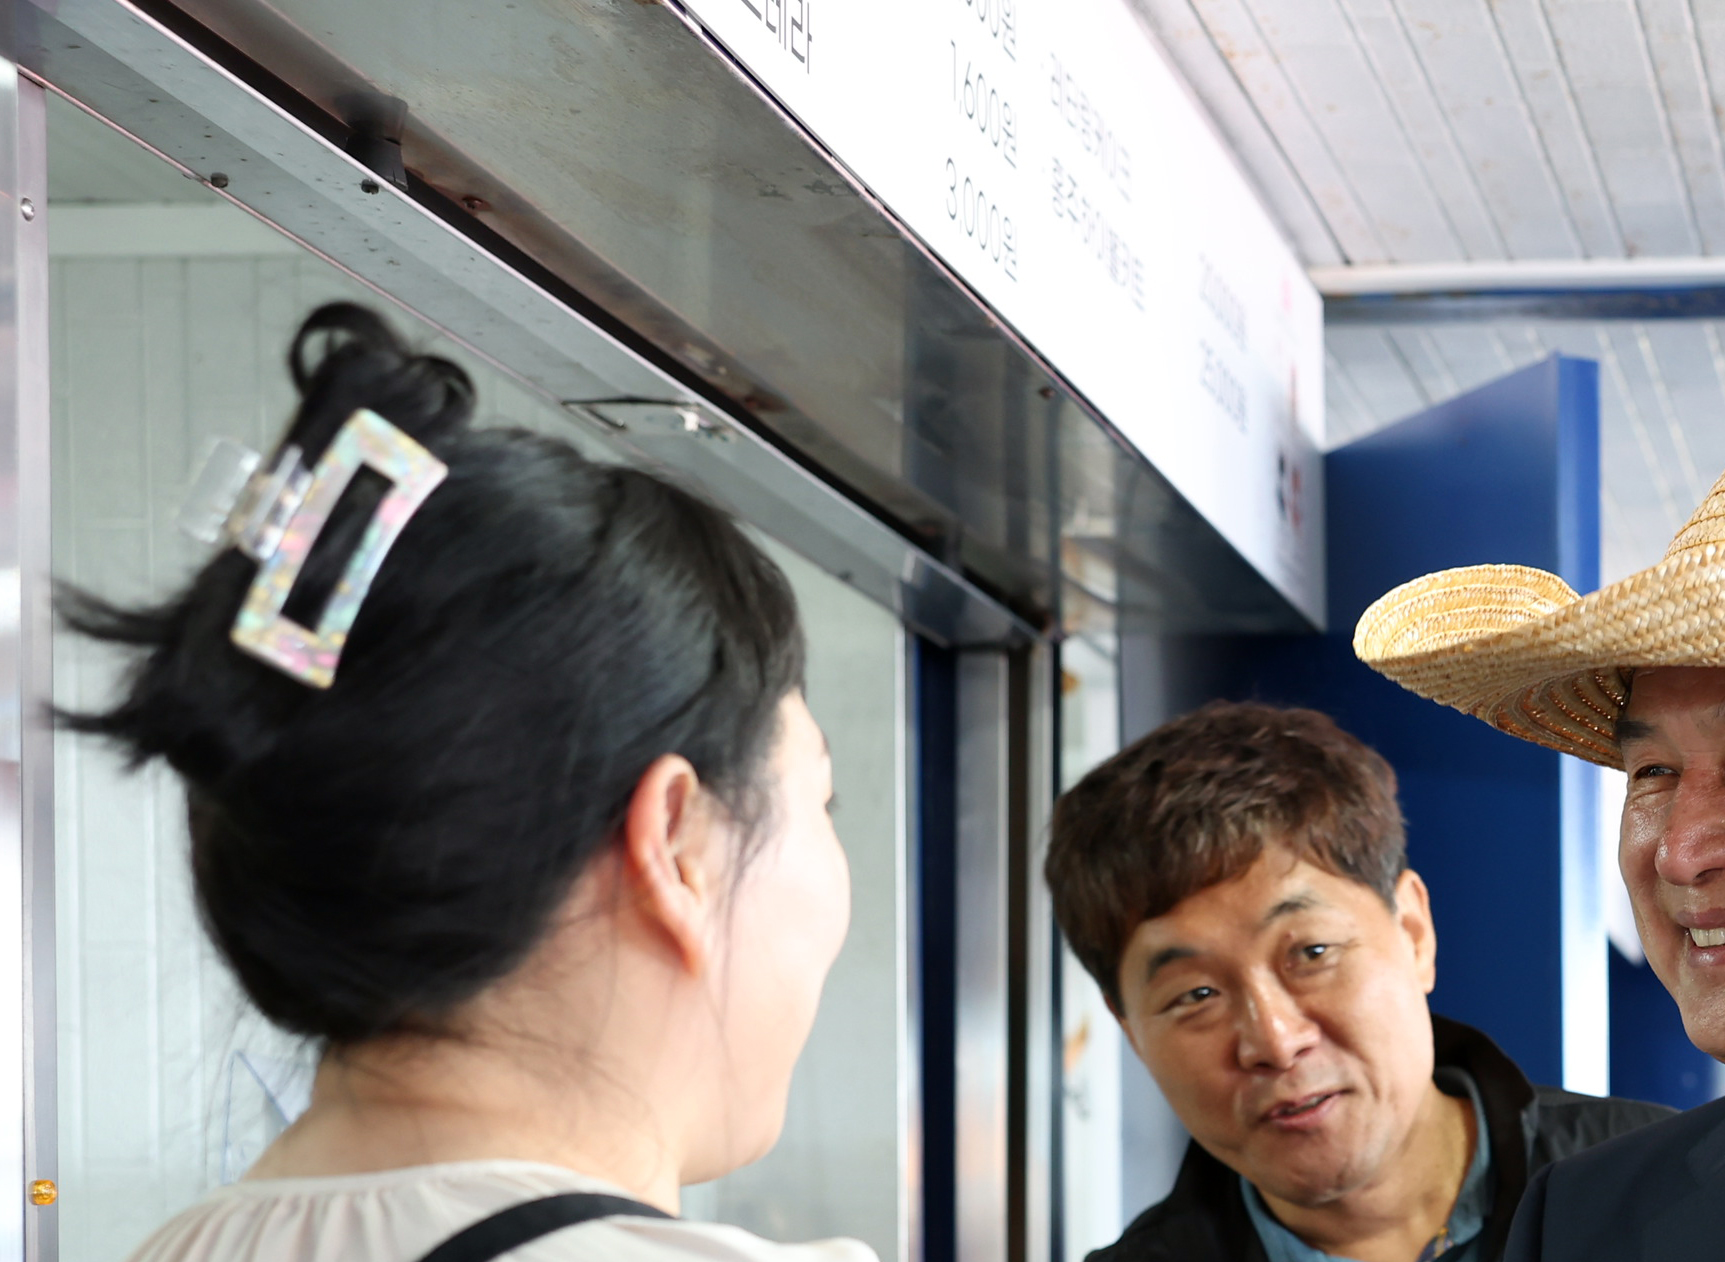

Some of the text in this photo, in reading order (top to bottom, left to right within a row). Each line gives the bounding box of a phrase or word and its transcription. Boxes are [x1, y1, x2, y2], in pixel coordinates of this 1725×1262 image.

[740, 0, 813, 75] 테라
[950, 38, 1018, 170] 1,600원
[945, 157, 1018, 283] 3,000원
